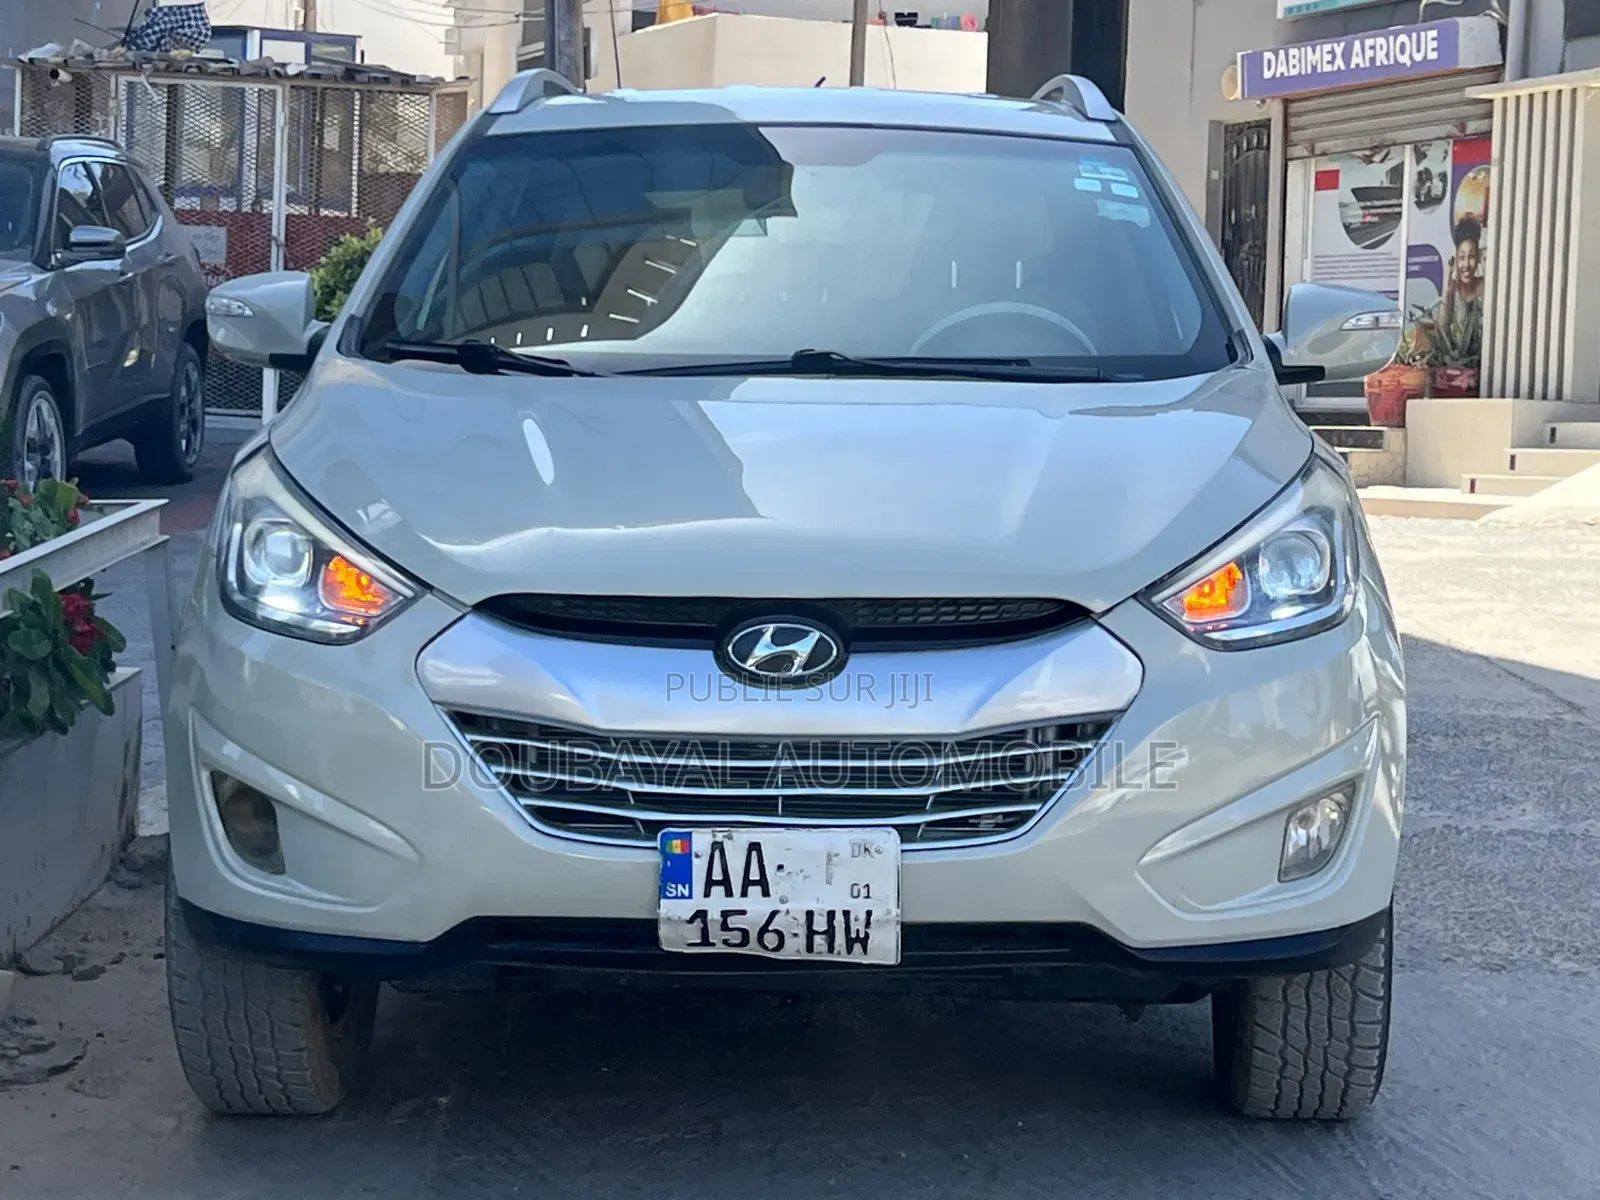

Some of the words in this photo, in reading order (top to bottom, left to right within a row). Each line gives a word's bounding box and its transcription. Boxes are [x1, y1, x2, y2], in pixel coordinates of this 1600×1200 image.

[1263, 42, 1346, 79] DABIMEX
[1350, 29, 1438, 68] AFRIQUE
[703, 841, 771, 898] AA
[665, 884, 690, 898] SN
[850, 882, 872, 900] 01
